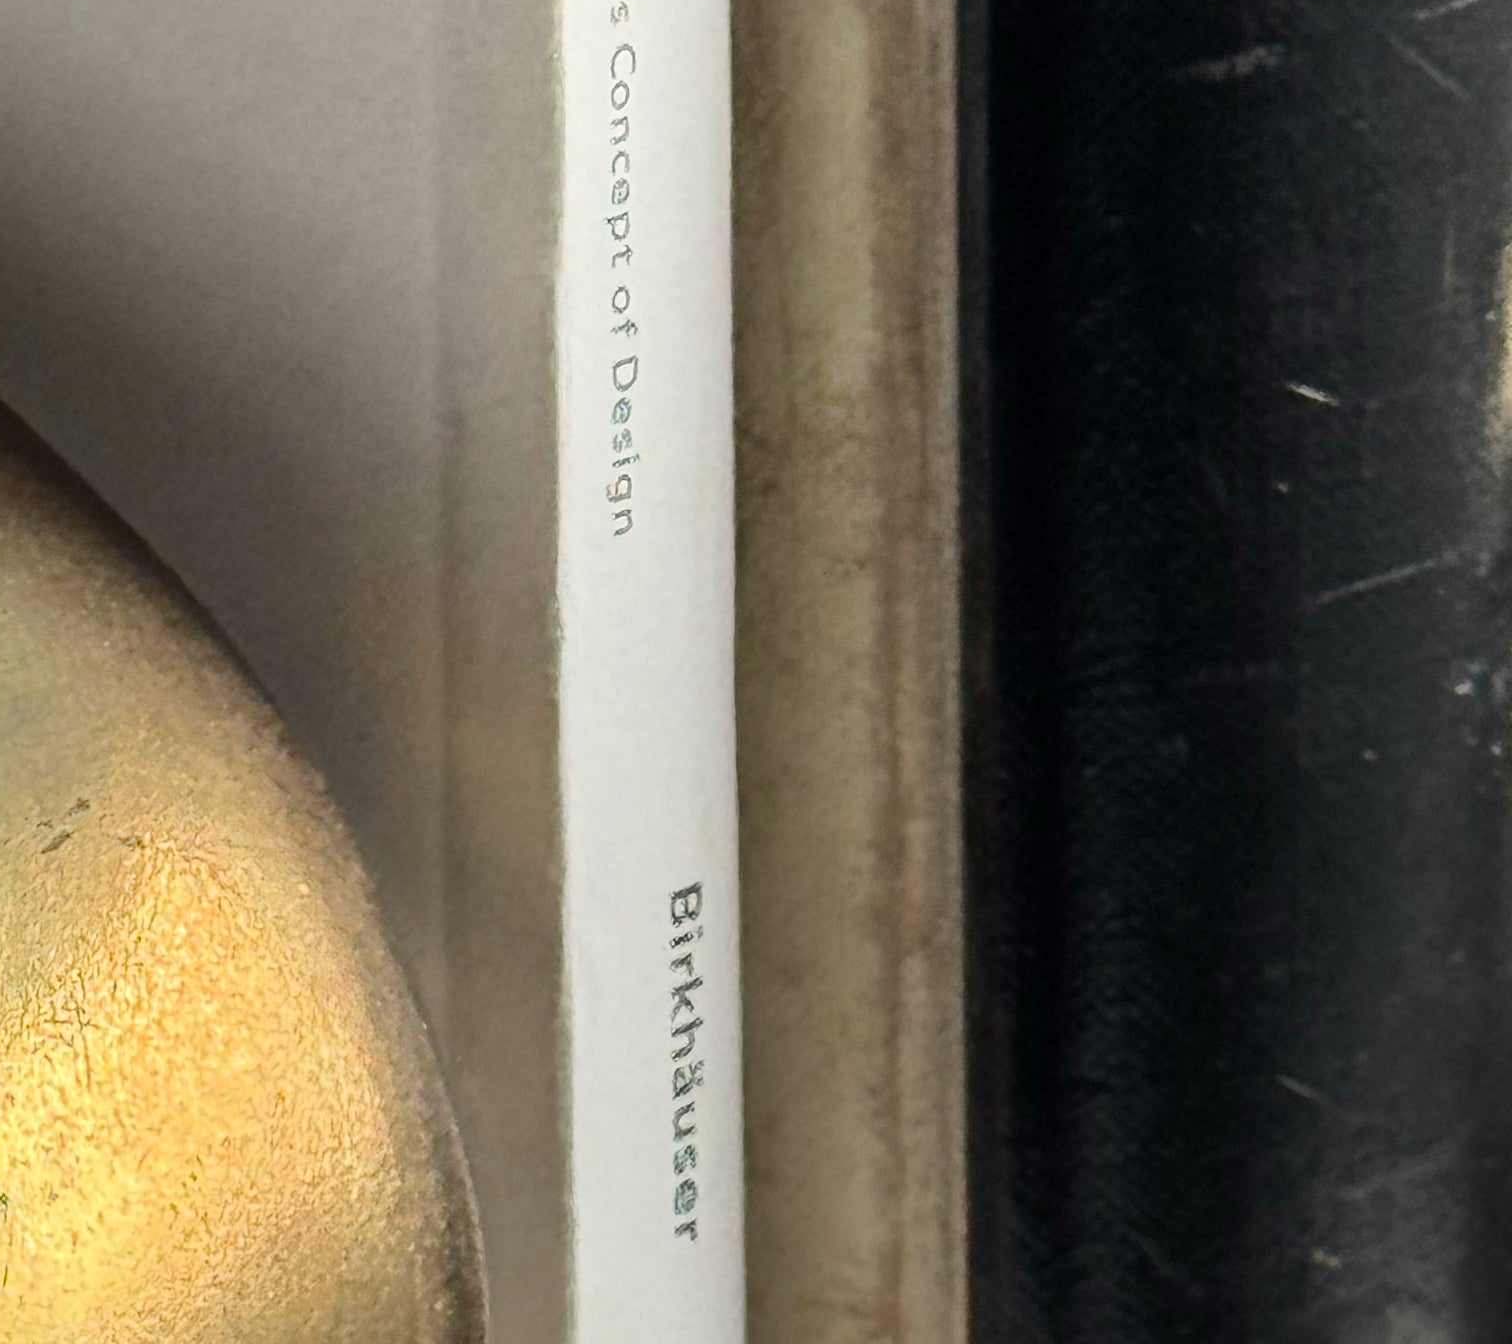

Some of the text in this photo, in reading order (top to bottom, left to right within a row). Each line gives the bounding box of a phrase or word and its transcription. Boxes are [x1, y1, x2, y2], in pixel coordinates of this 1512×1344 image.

[603, 42, 637, 269] Concept
[609, 285, 638, 339] of
[606, 355, 640, 537] Design
[669, 881, 705, 1242] Birkhäuser
